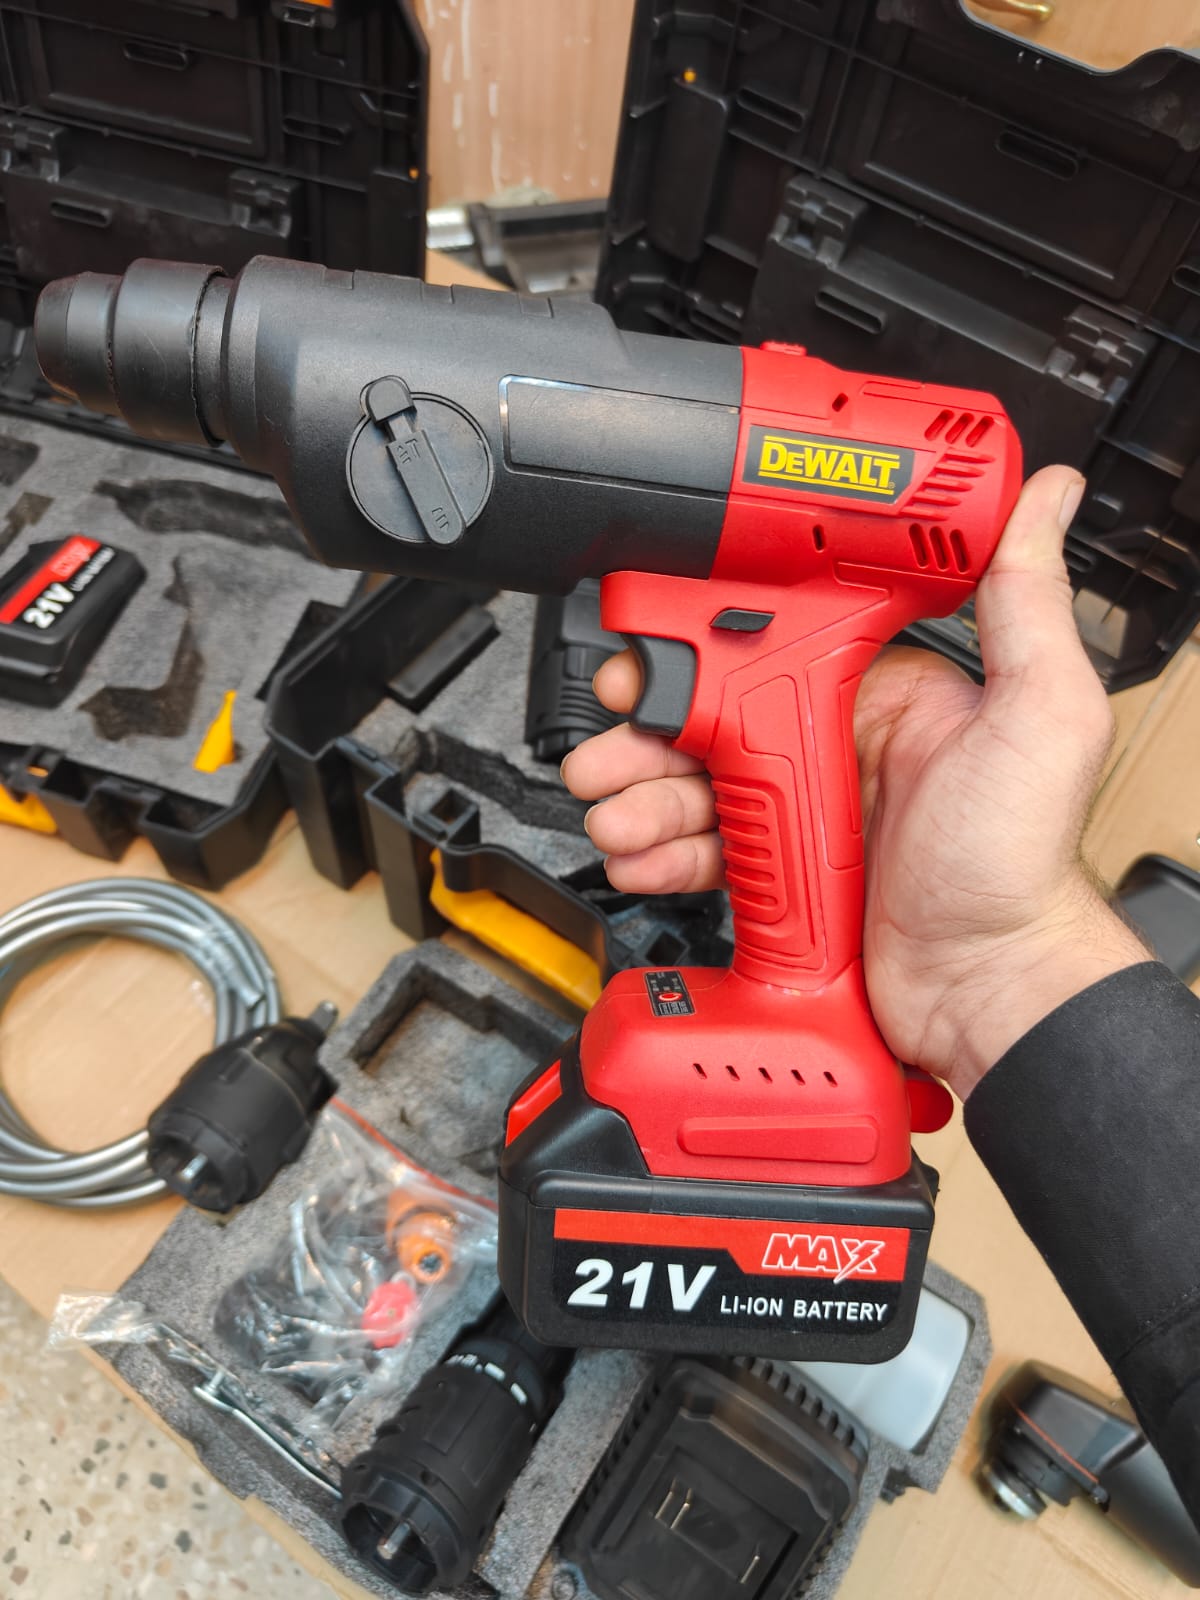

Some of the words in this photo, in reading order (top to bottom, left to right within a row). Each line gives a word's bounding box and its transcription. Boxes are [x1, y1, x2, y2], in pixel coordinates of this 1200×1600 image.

[23, 582, 74, 629] 21V
[761, 1233, 886, 1284] MAX
[567, 1258, 718, 1312] 21V
[720, 1295, 783, 1317] LI-ION
[793, 1299, 888, 1322] BATTERY
